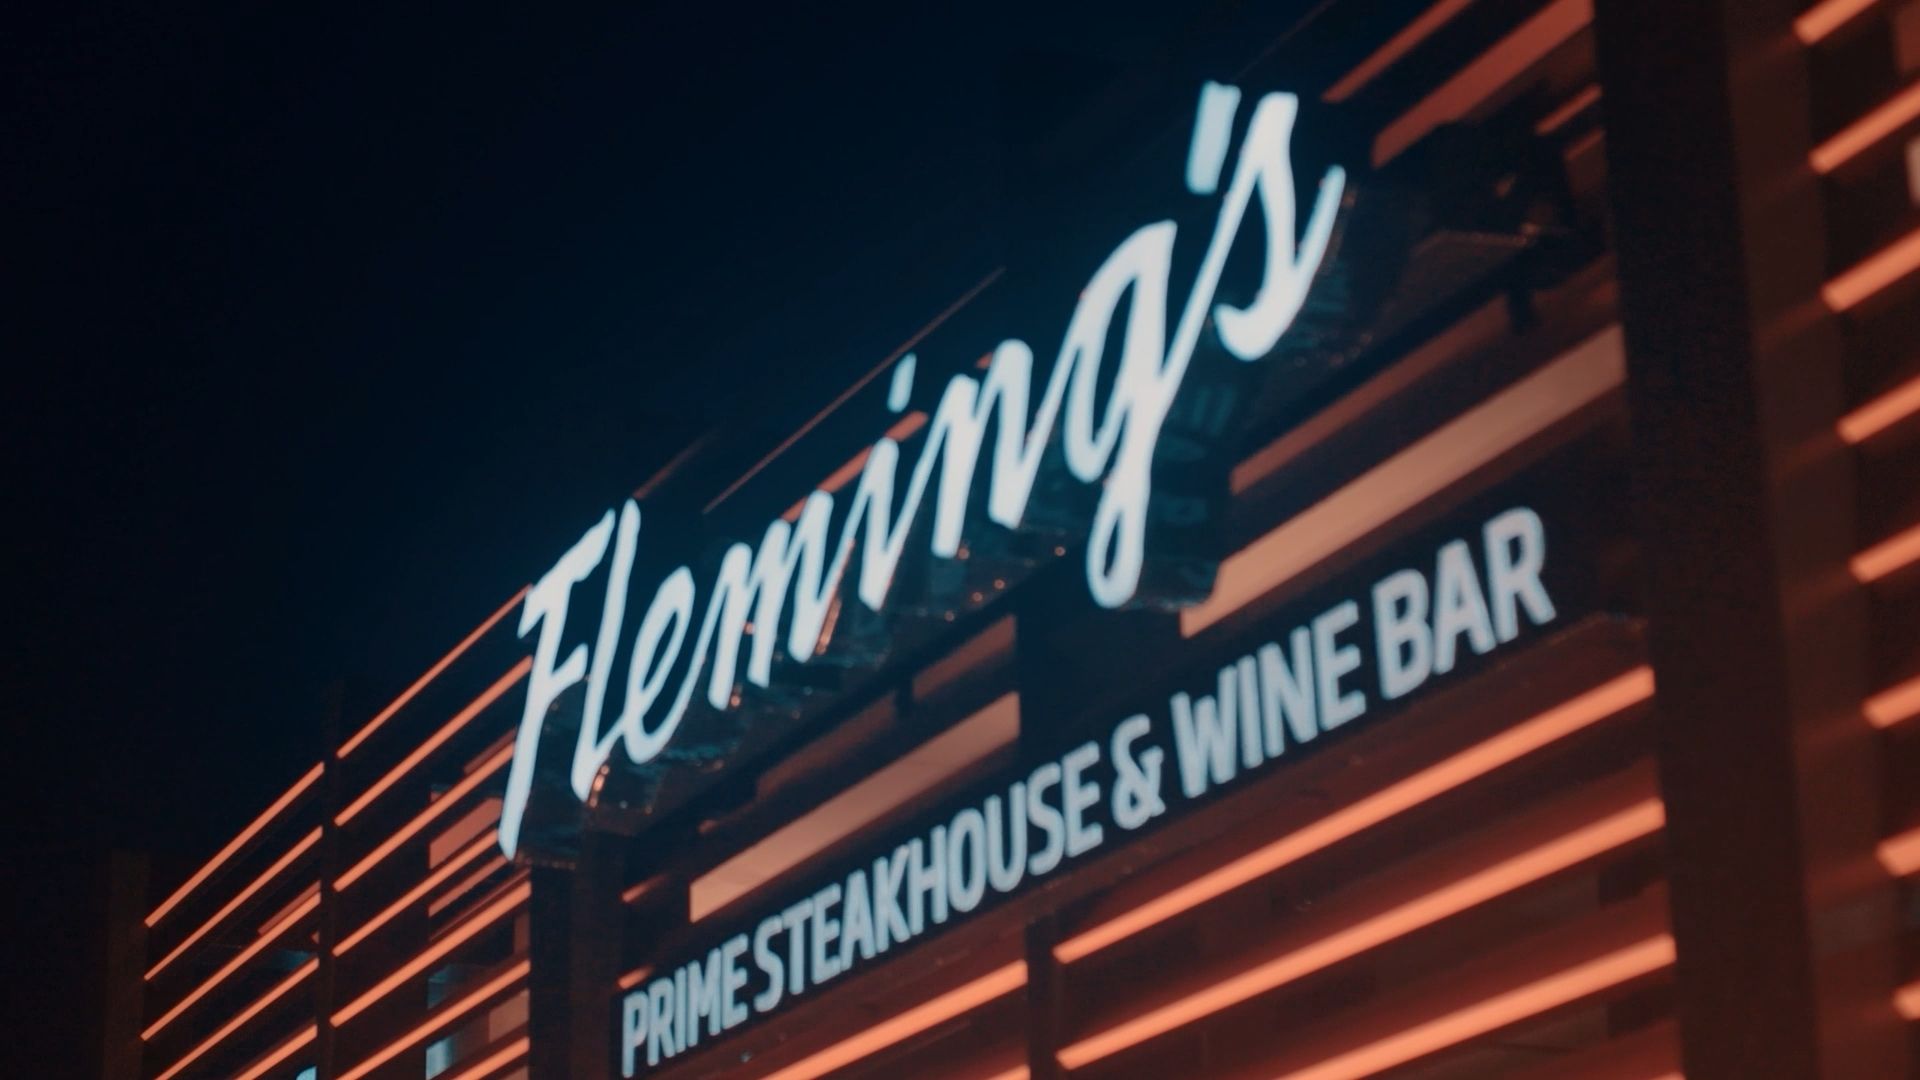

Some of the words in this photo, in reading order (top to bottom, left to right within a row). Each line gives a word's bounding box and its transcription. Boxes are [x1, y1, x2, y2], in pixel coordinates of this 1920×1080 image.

[499, 80, 1347, 861] Fleming's
[621, 932, 748, 1078] PRIME
[753, 740, 1104, 1013] STEAKHOUSE
[1111, 713, 1166, 830] &
[1169, 599, 1367, 799] WINE
[1371, 506, 1557, 701] BAR
